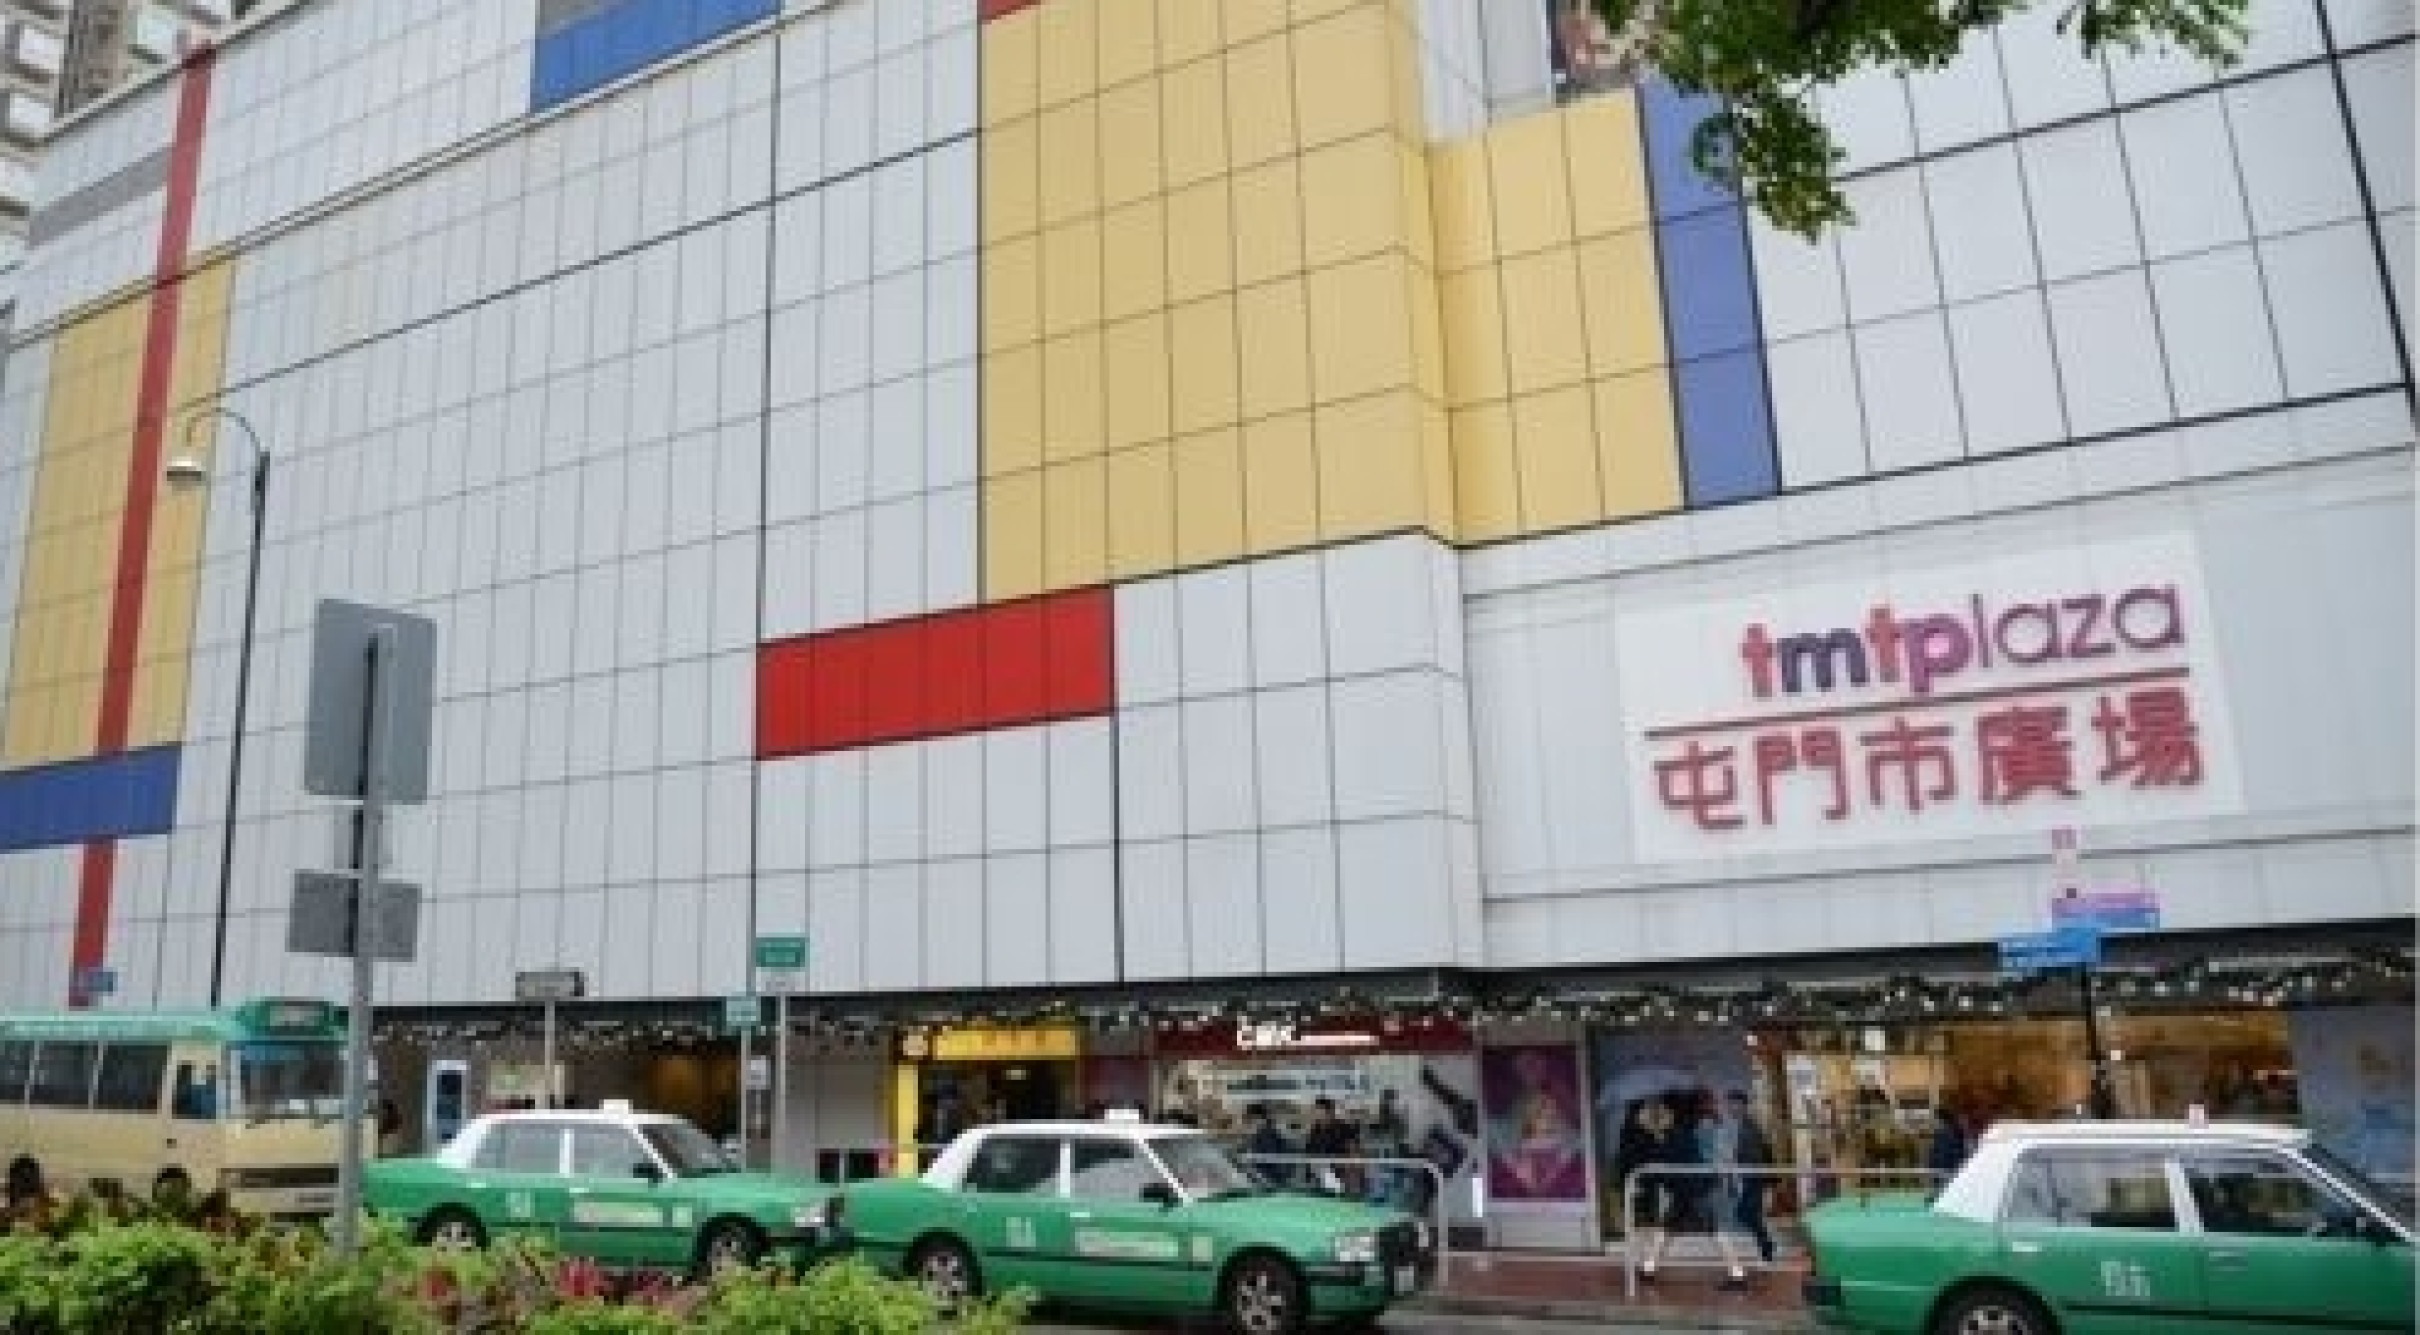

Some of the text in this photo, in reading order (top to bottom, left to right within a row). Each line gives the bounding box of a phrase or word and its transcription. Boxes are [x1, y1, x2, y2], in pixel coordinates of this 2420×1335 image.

[1741, 584, 2185, 699] tmtplaza
[1653, 686, 2204, 830] 屯門市廣場
